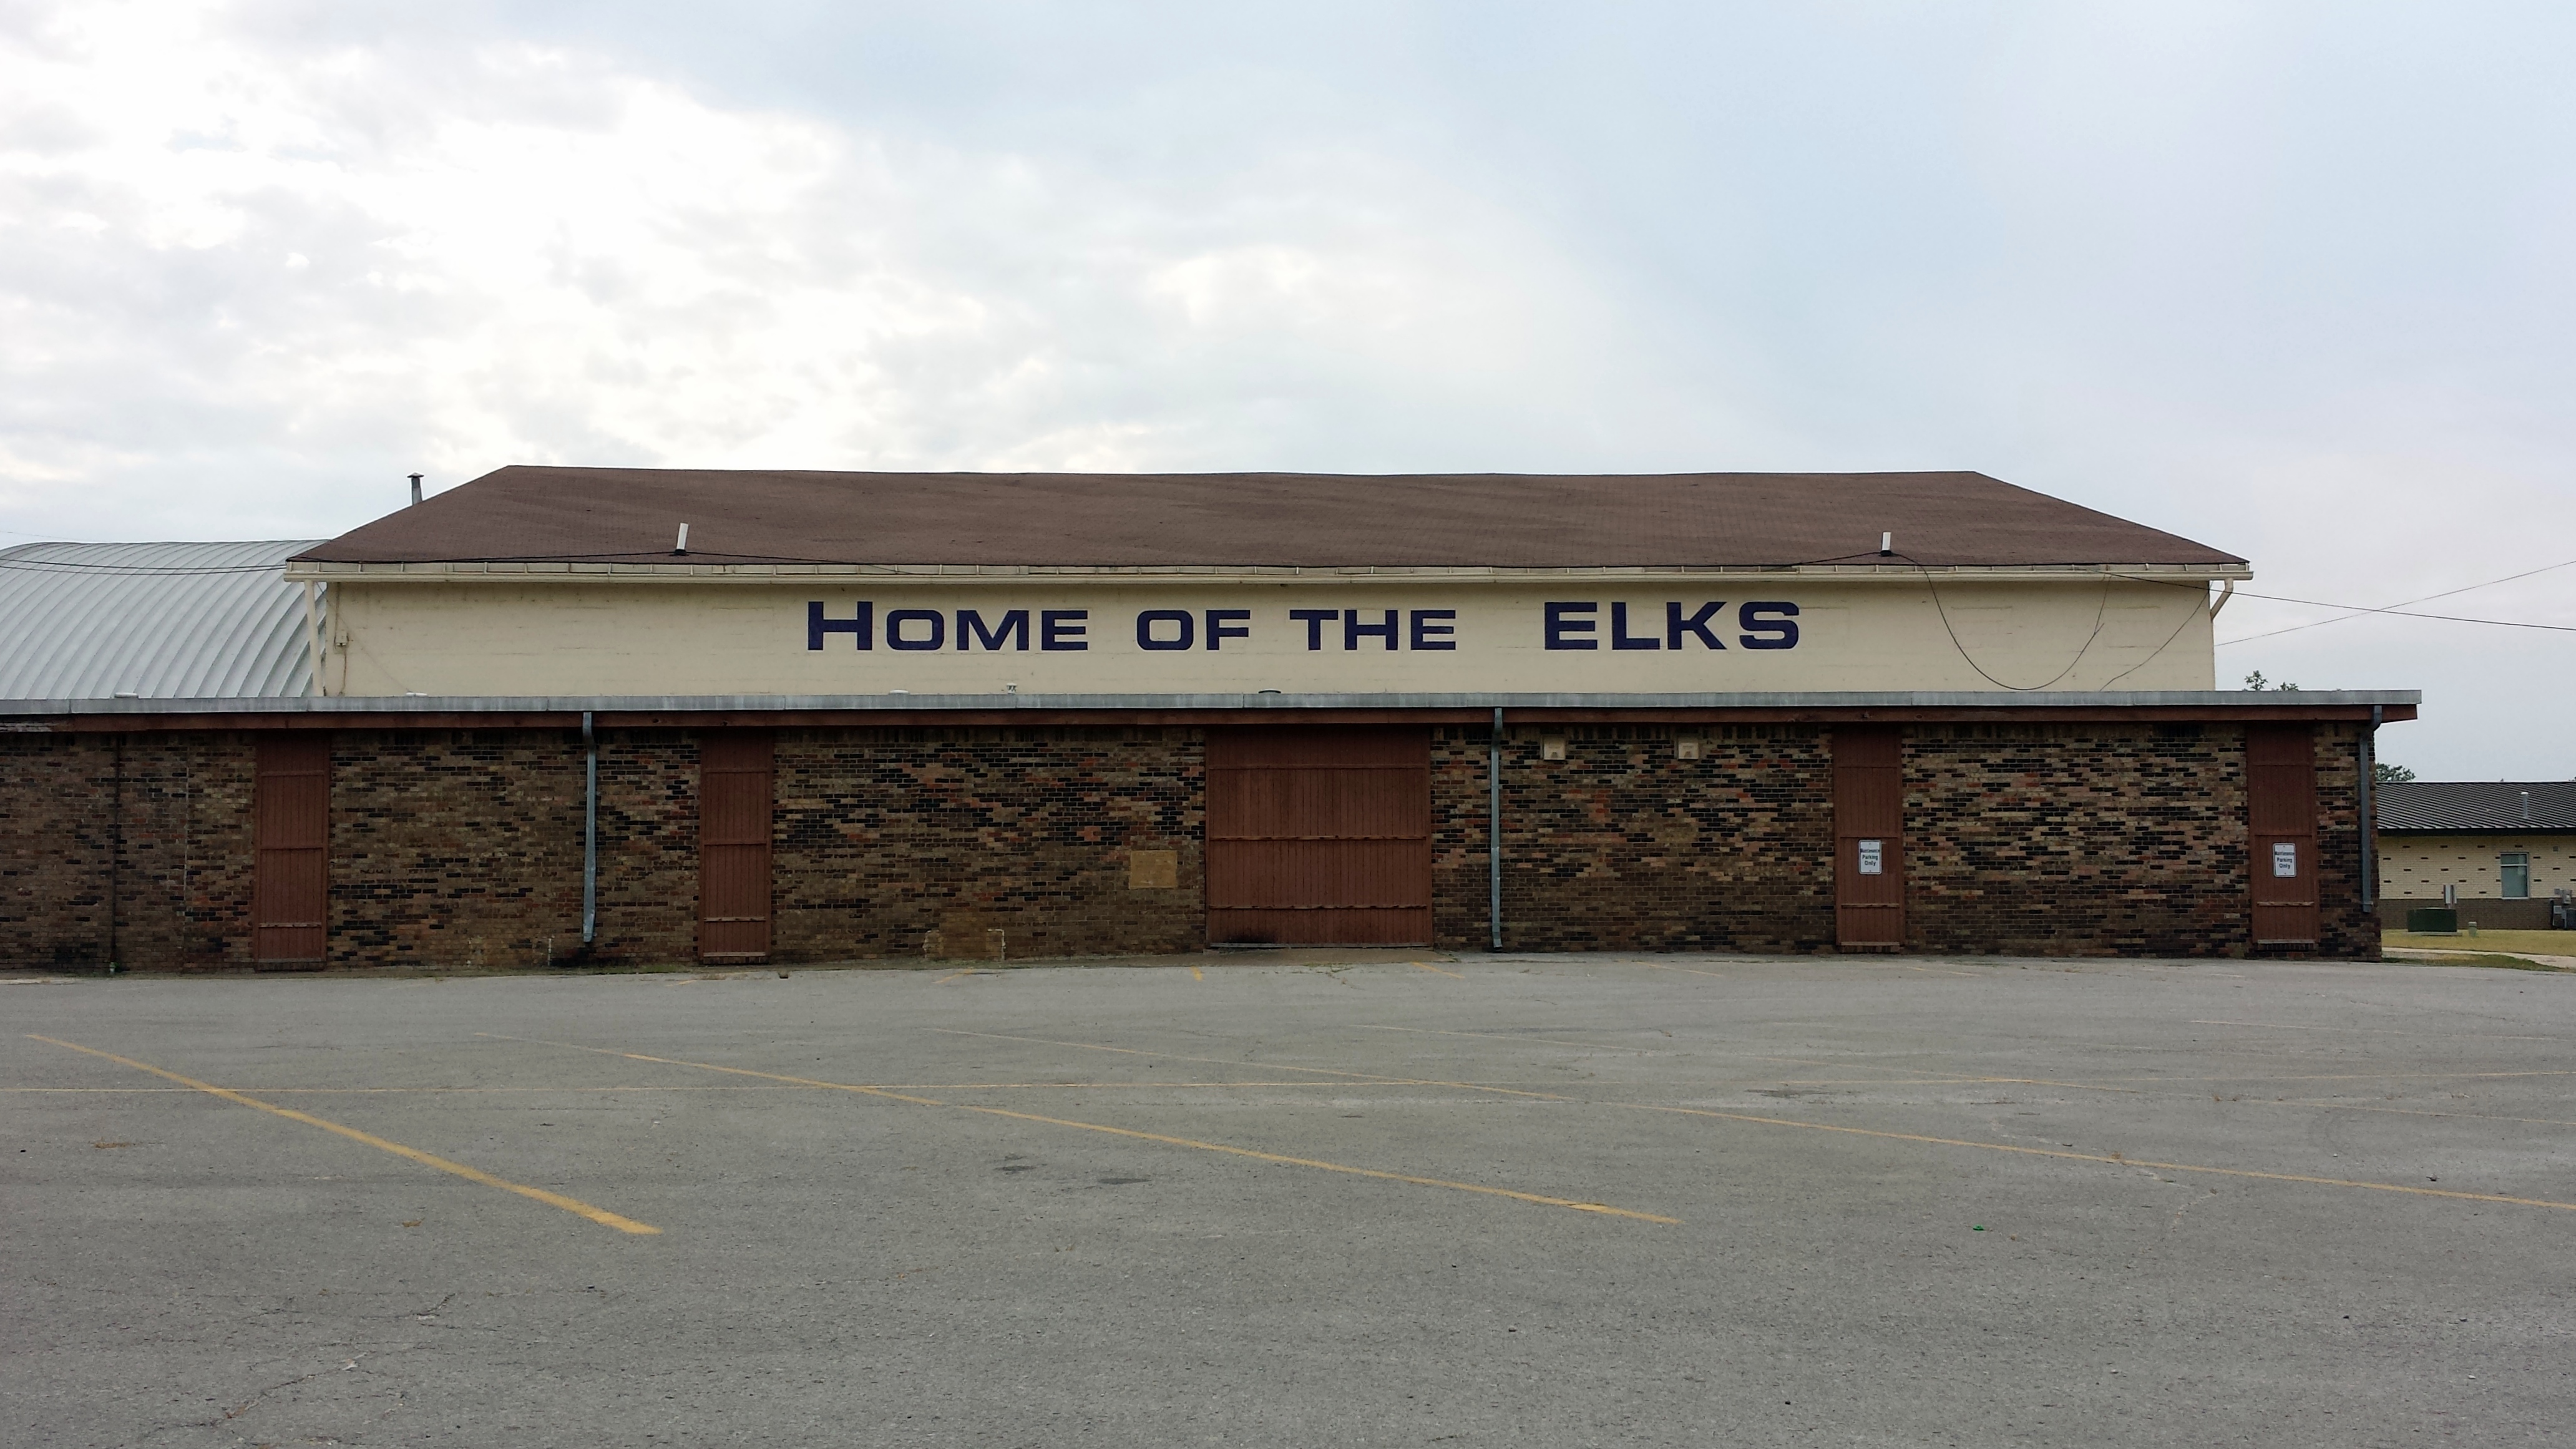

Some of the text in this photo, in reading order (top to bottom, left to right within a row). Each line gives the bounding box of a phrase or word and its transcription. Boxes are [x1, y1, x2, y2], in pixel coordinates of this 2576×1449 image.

[807, 600, 1800, 651] HOME OF THE ELKS
